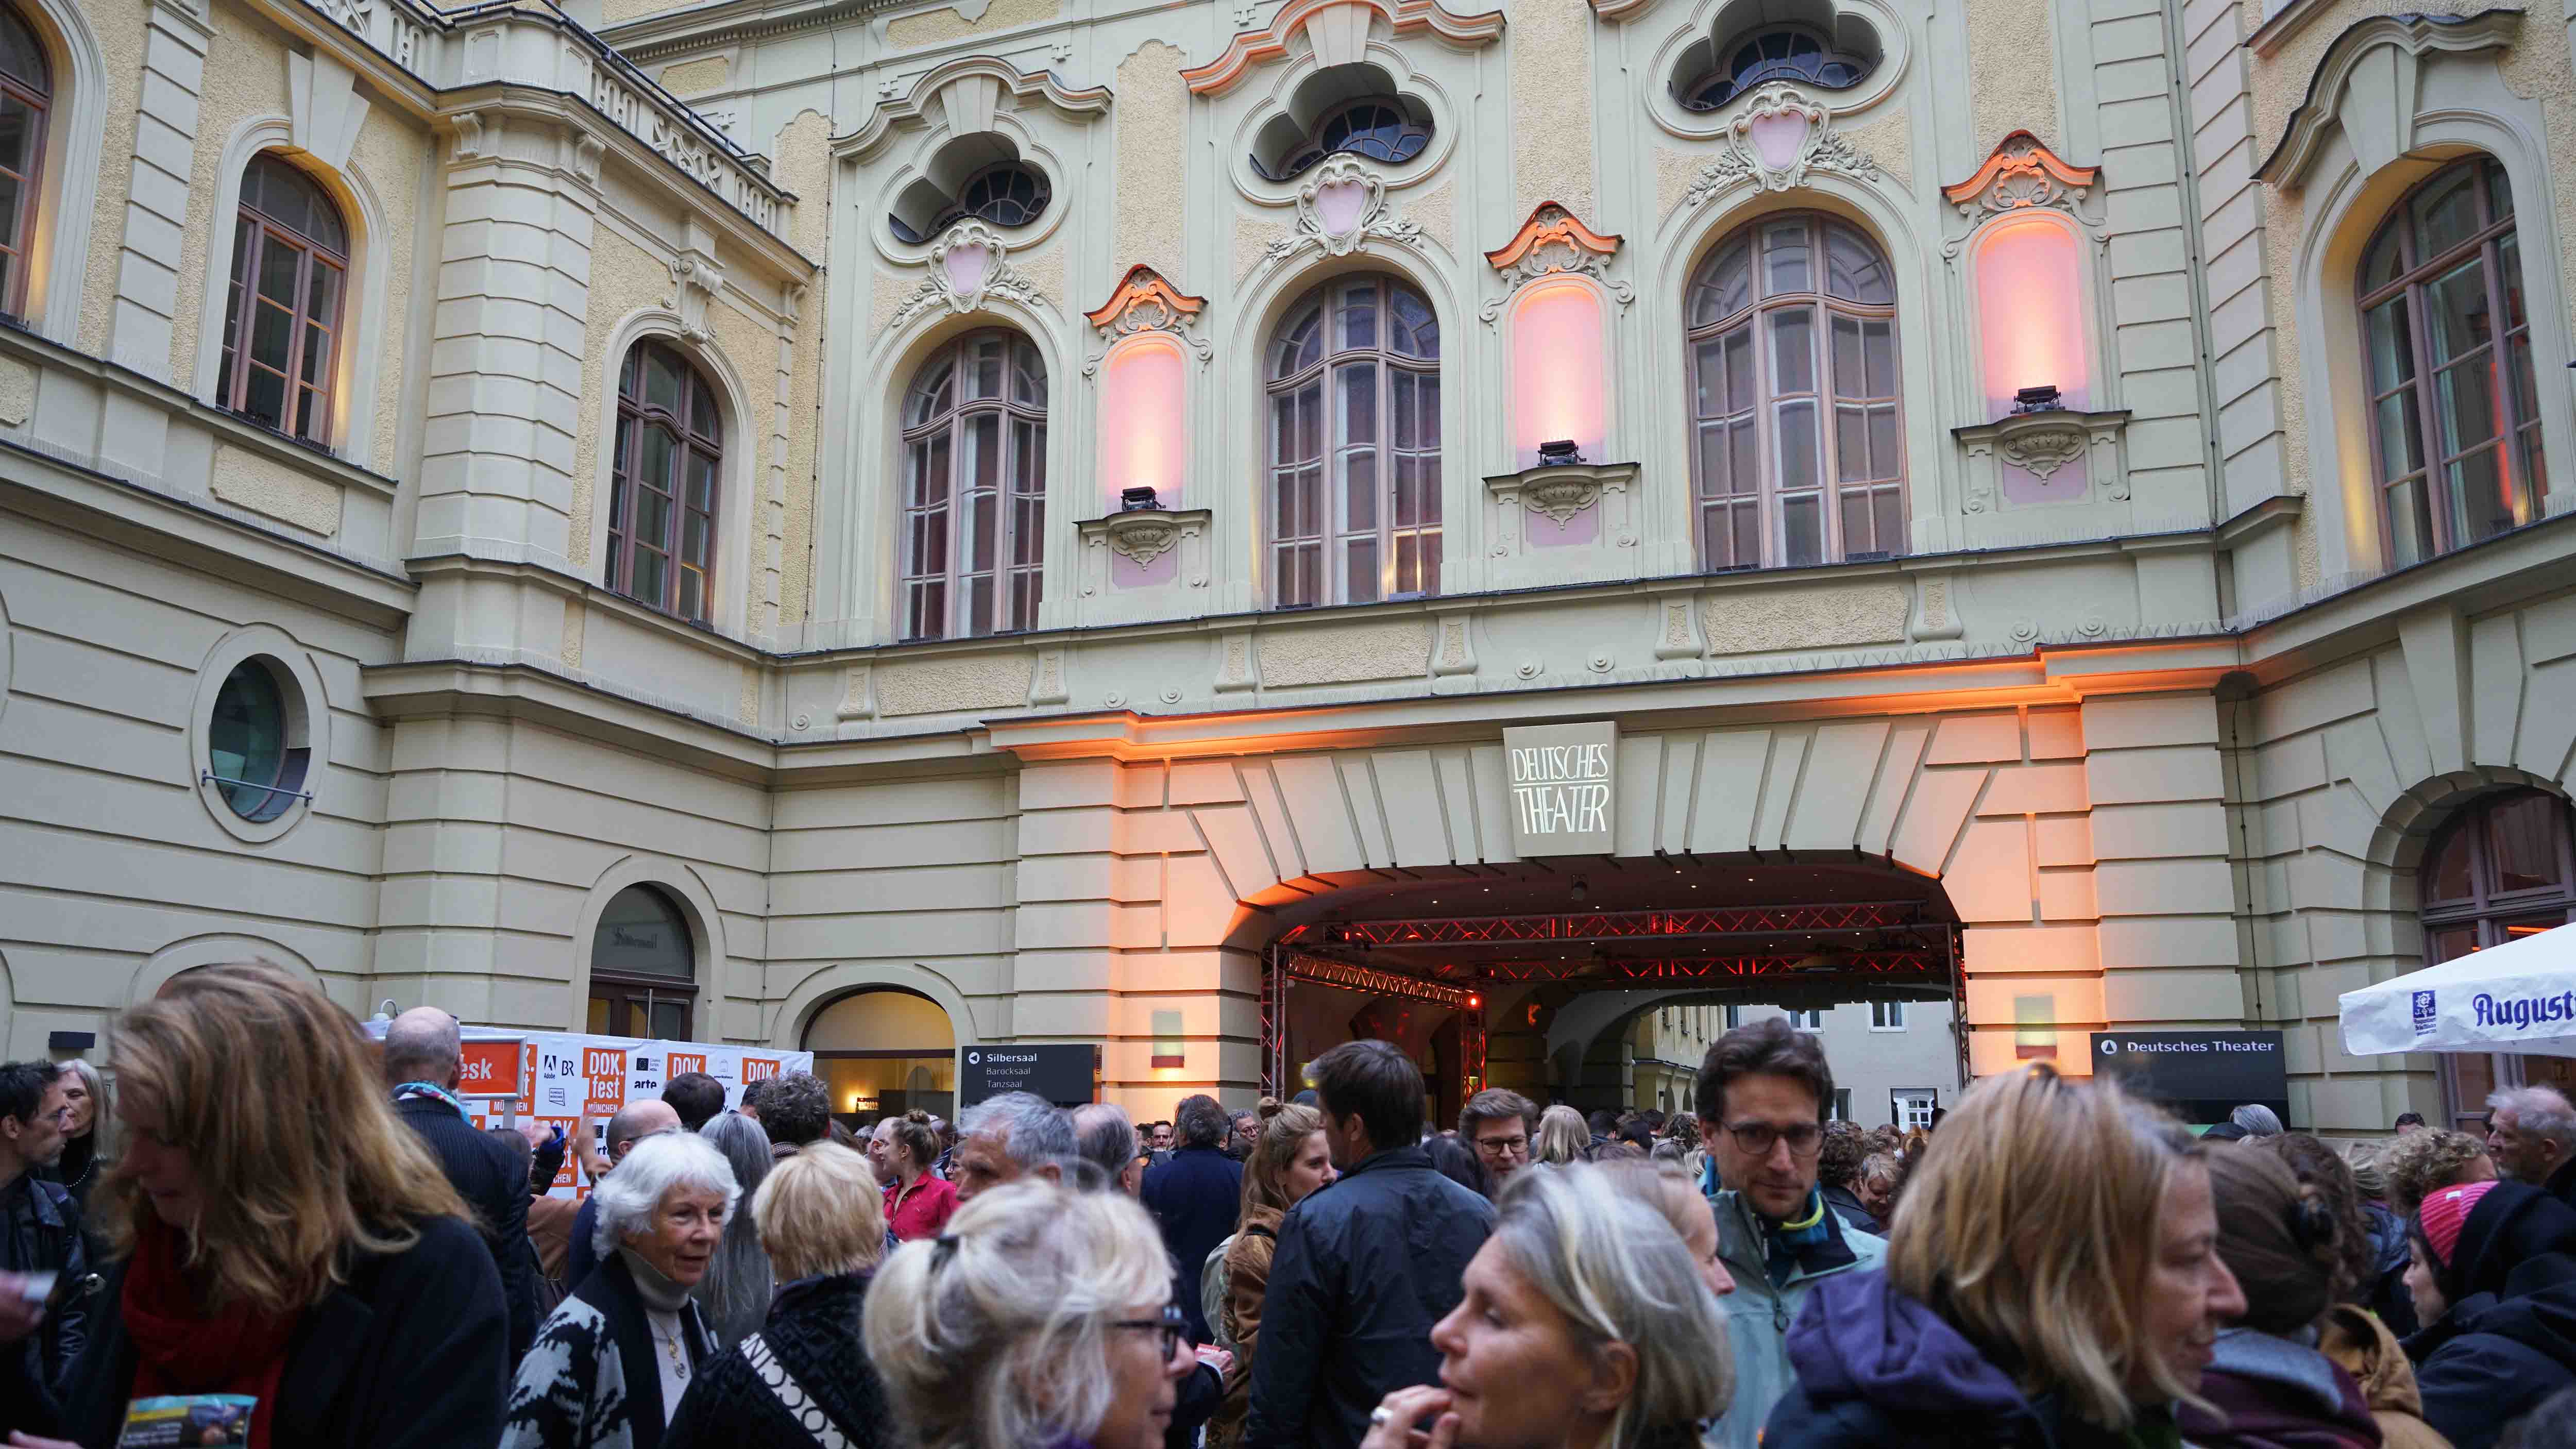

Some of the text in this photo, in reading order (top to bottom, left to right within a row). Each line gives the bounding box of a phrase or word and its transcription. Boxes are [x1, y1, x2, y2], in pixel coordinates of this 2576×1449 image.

[1512, 743, 1608, 781] DEUTSCHES
[1513, 784, 1609, 834] THEATER
[2472, 990, 2576, 1030] August
[2127, 1040, 2275, 1052] Deutsches Theater
[589, 1051, 624, 1075] DOK.
[986, 1053, 1037, 1062] Silbersaal
[461, 1053, 493, 1080] esk
[561, 1060, 574, 1076] BR
[986, 1067, 1031, 1075] Barocksaal
[592, 1075, 620, 1099] fest
[634, 1080, 657, 1089] arte
[987, 1080, 1023, 1088] Tanzsaal
[587, 1102, 618, 1114] MÜNCHEN
[553, 1173, 571, 1184] CHEN
